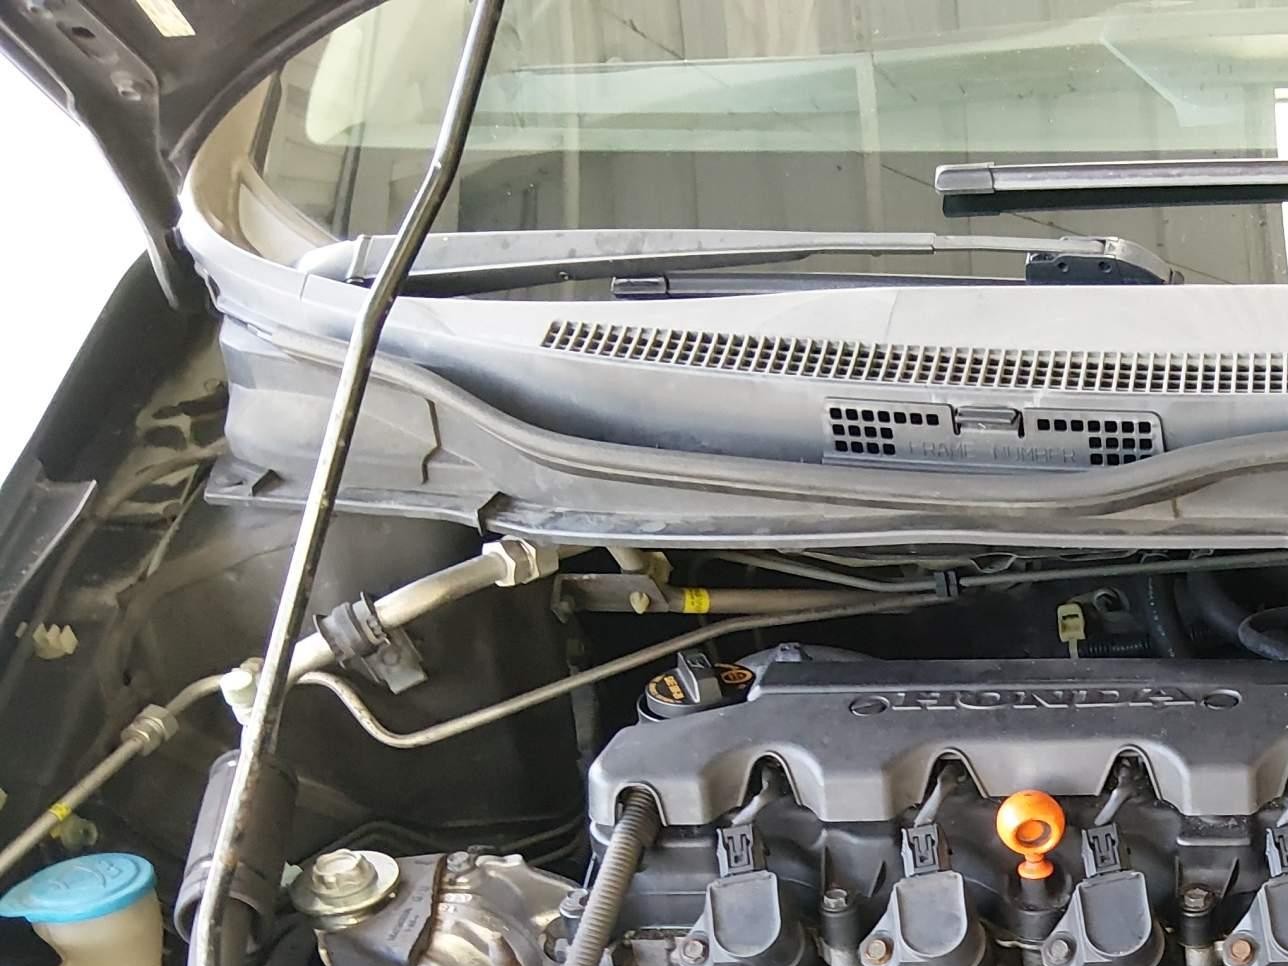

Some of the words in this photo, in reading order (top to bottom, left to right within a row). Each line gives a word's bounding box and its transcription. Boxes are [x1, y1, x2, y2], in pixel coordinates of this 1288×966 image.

[908, 441, 974, 460] FRAME
[993, 445, 1077, 464] NUMBER
[891, 687, 1197, 711] HONDA
